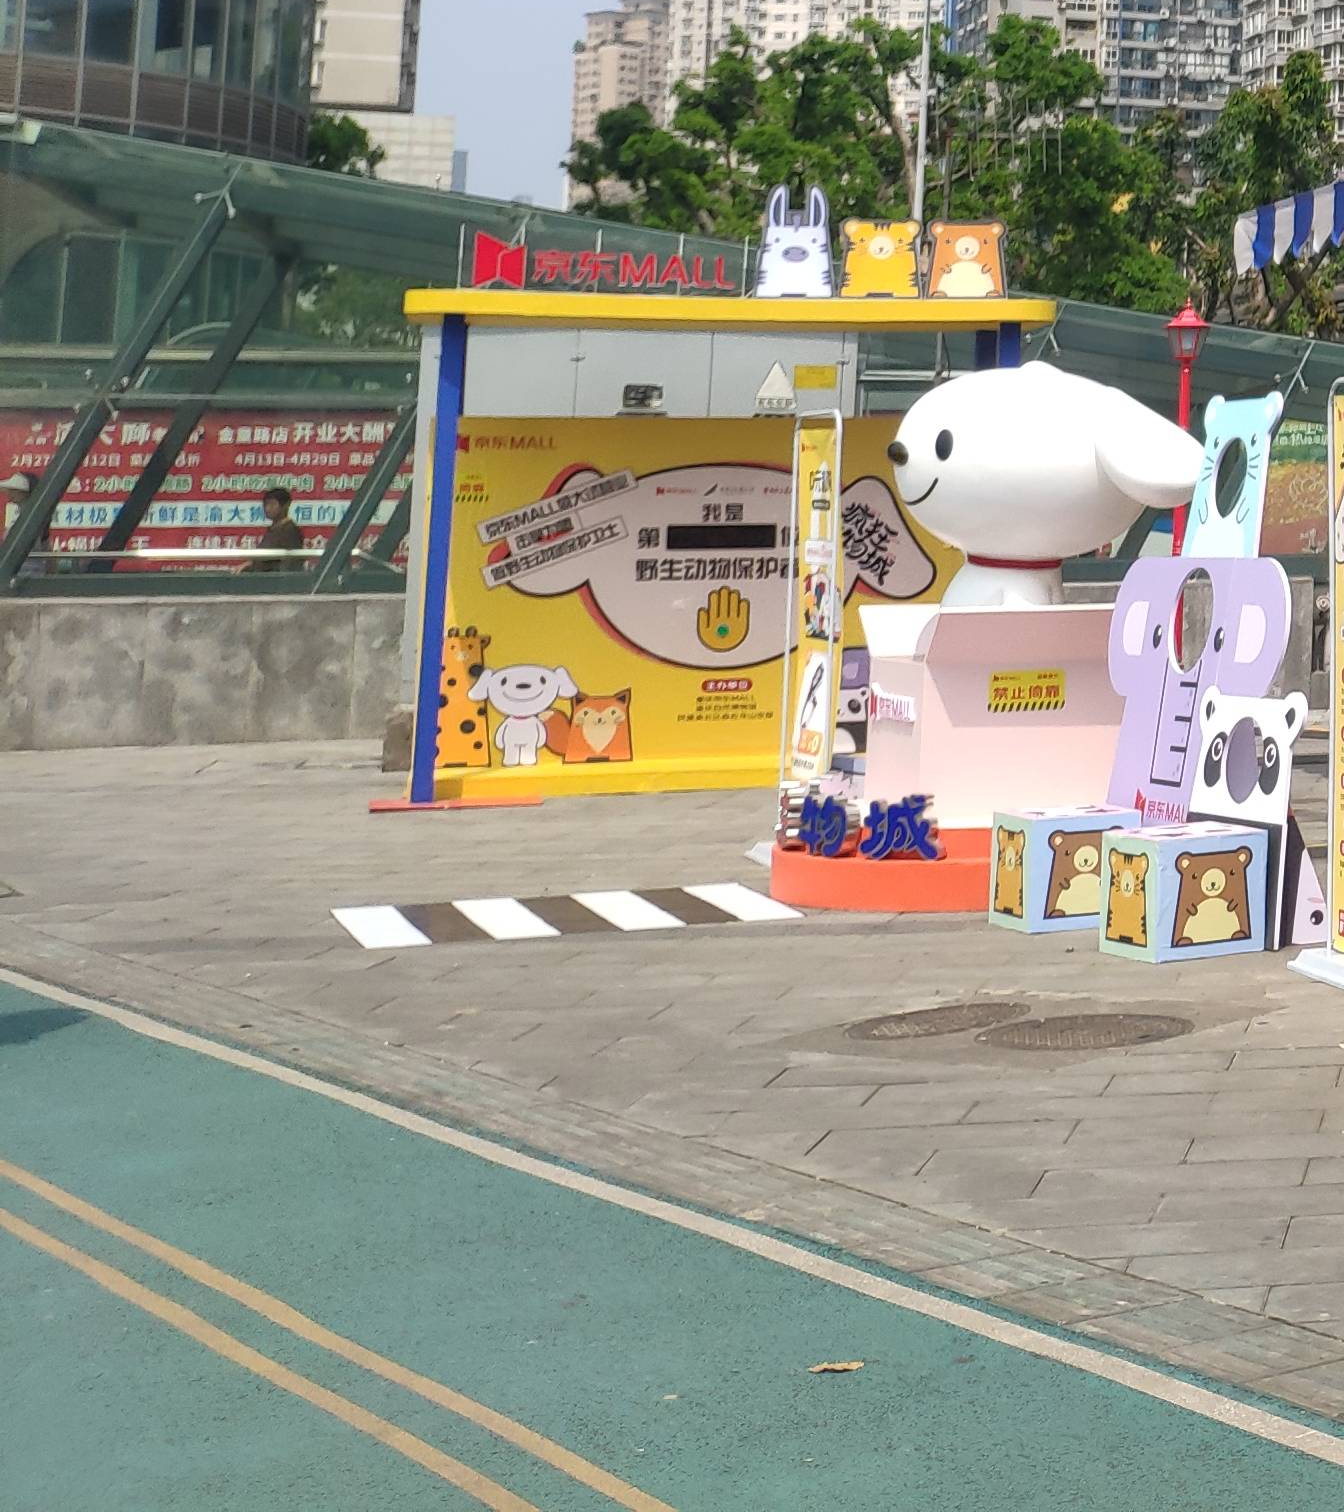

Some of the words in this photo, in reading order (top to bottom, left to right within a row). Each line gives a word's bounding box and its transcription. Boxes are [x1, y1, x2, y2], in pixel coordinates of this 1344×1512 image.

[533, 248, 736, 290] 京东MALL
[702, 502, 744, 522] 我是
[638, 527, 660, 549] 第
